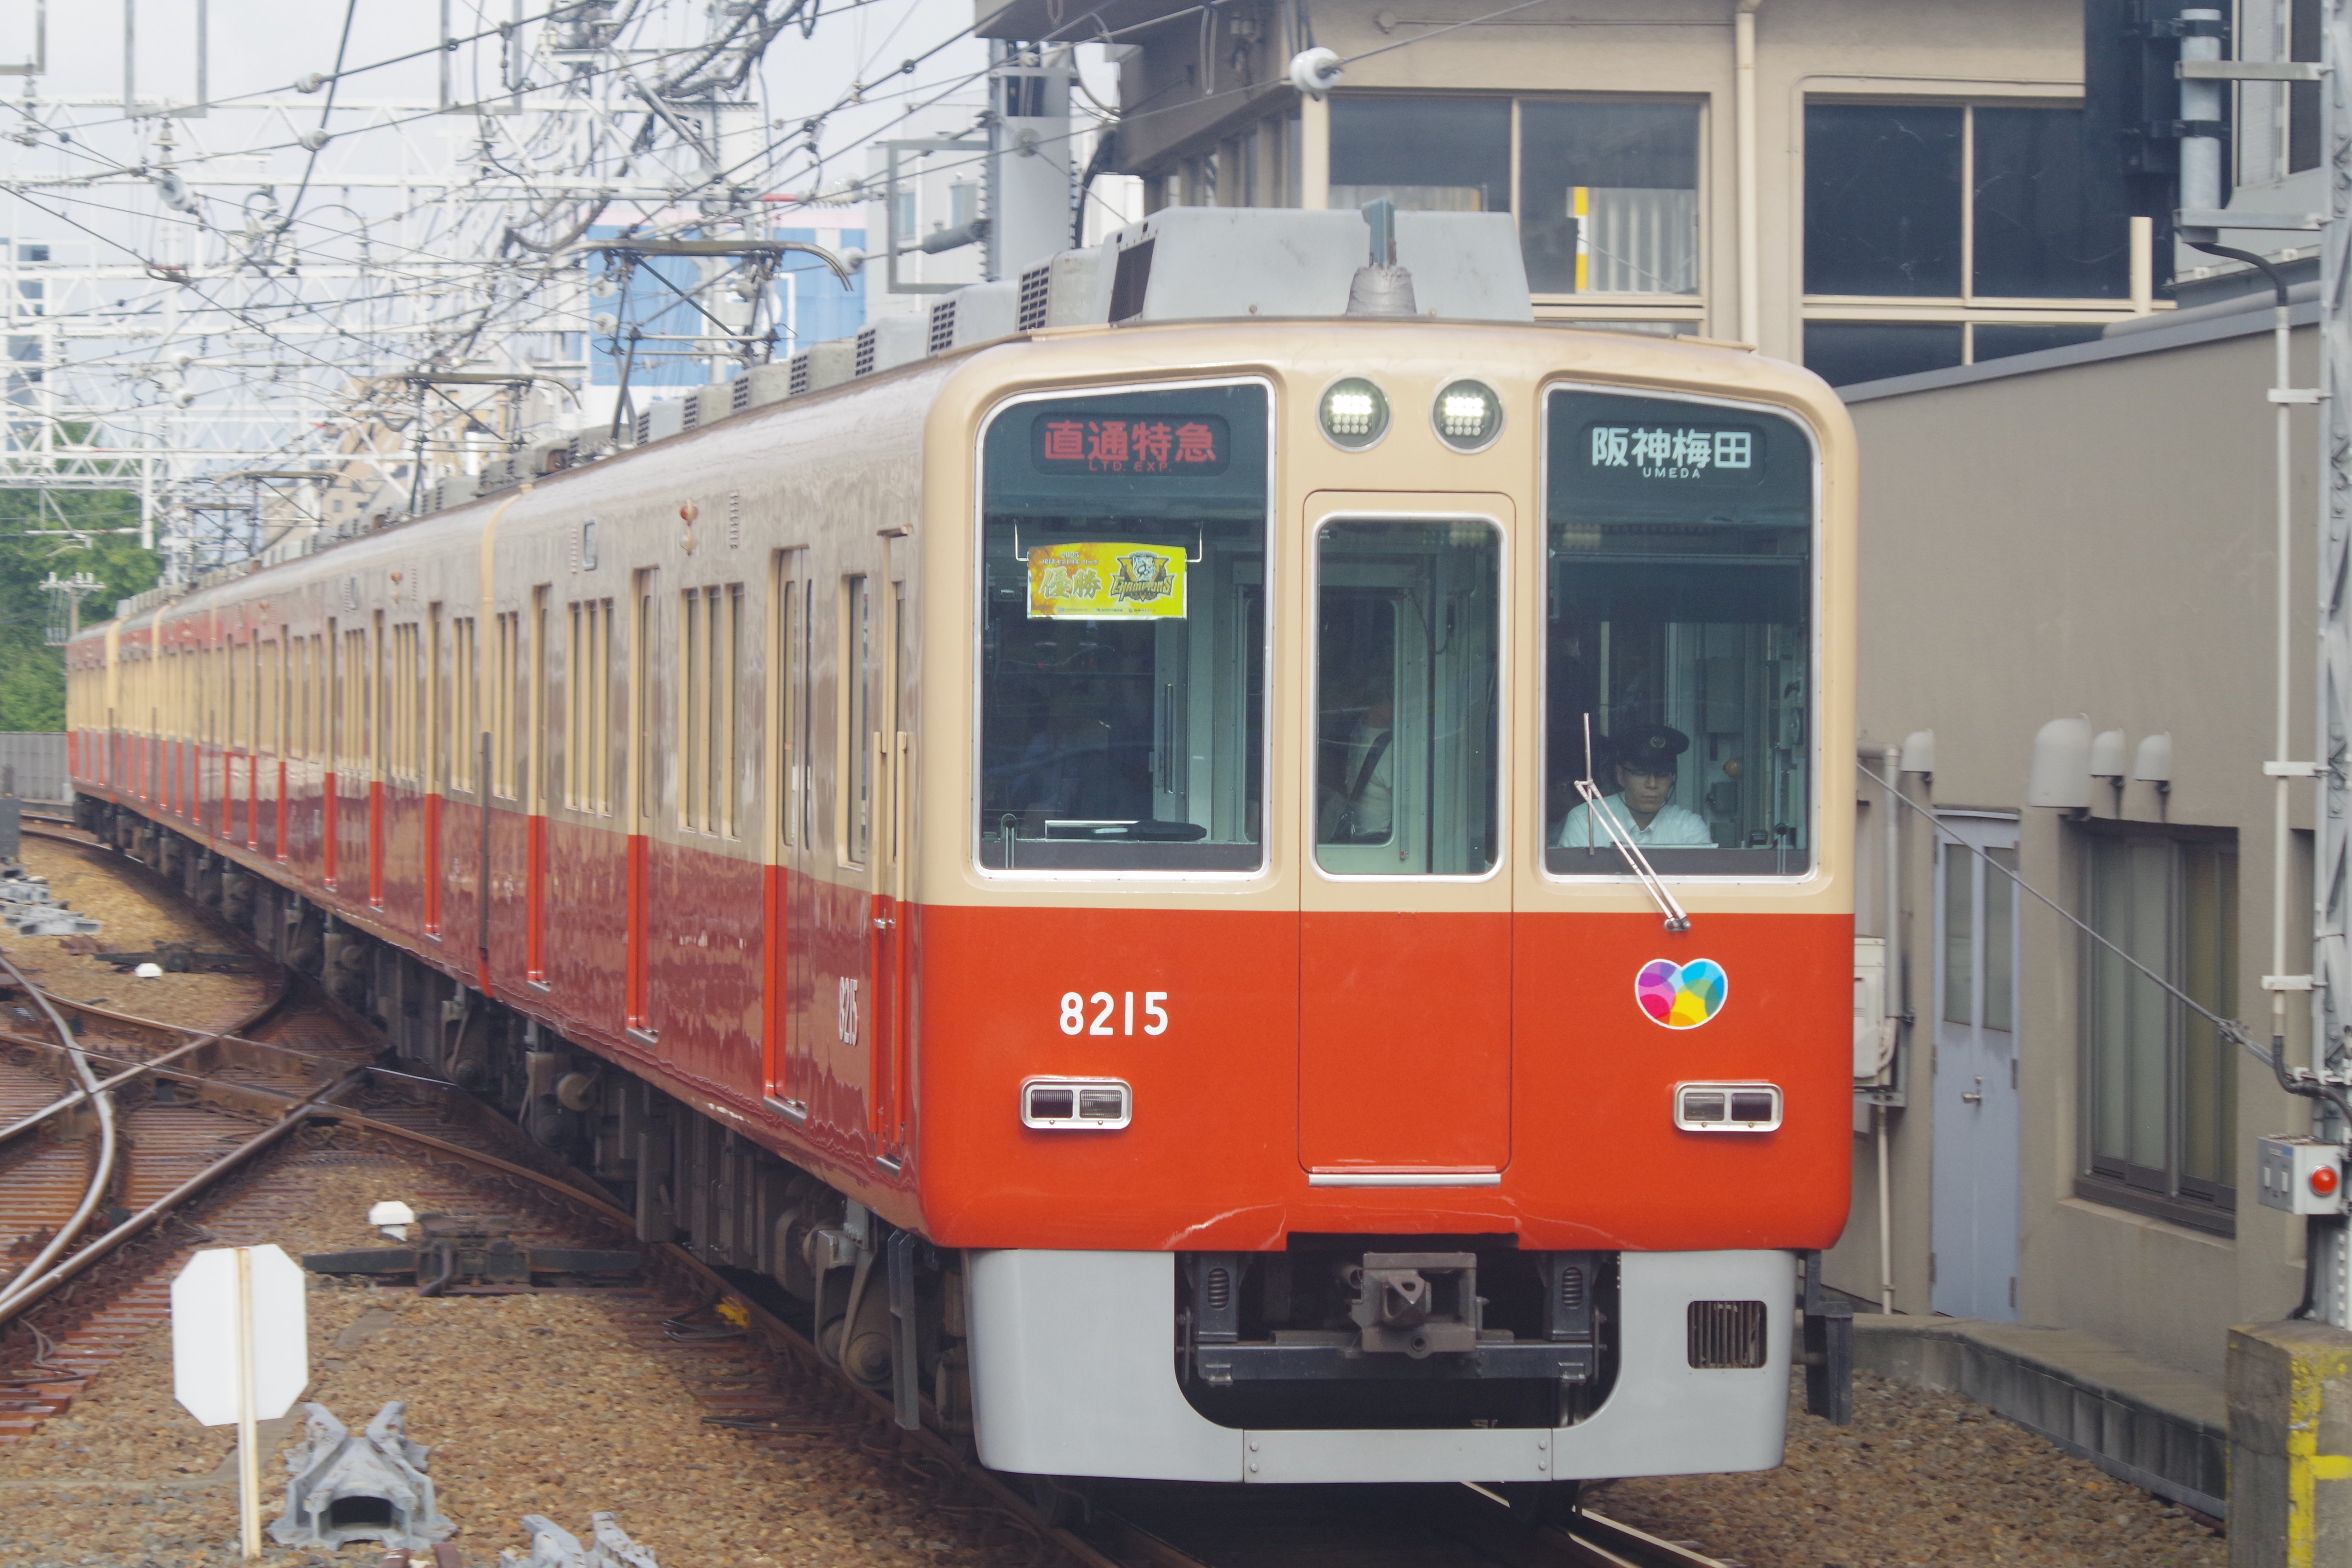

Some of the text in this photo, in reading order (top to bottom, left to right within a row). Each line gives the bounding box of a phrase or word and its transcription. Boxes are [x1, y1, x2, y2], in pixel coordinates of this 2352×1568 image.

[1044, 420, 1216, 462] 直通特急
[1592, 427, 1752, 469] 阪神梅田
[1089, 461, 1172, 472] LTD. EXP.
[1642, 467, 1701, 479] UMEDA
[1038, 566, 1102, 599] 優勝
[839, 976, 858, 1046] 8215
[1059, 991, 1169, 1036] 8215
